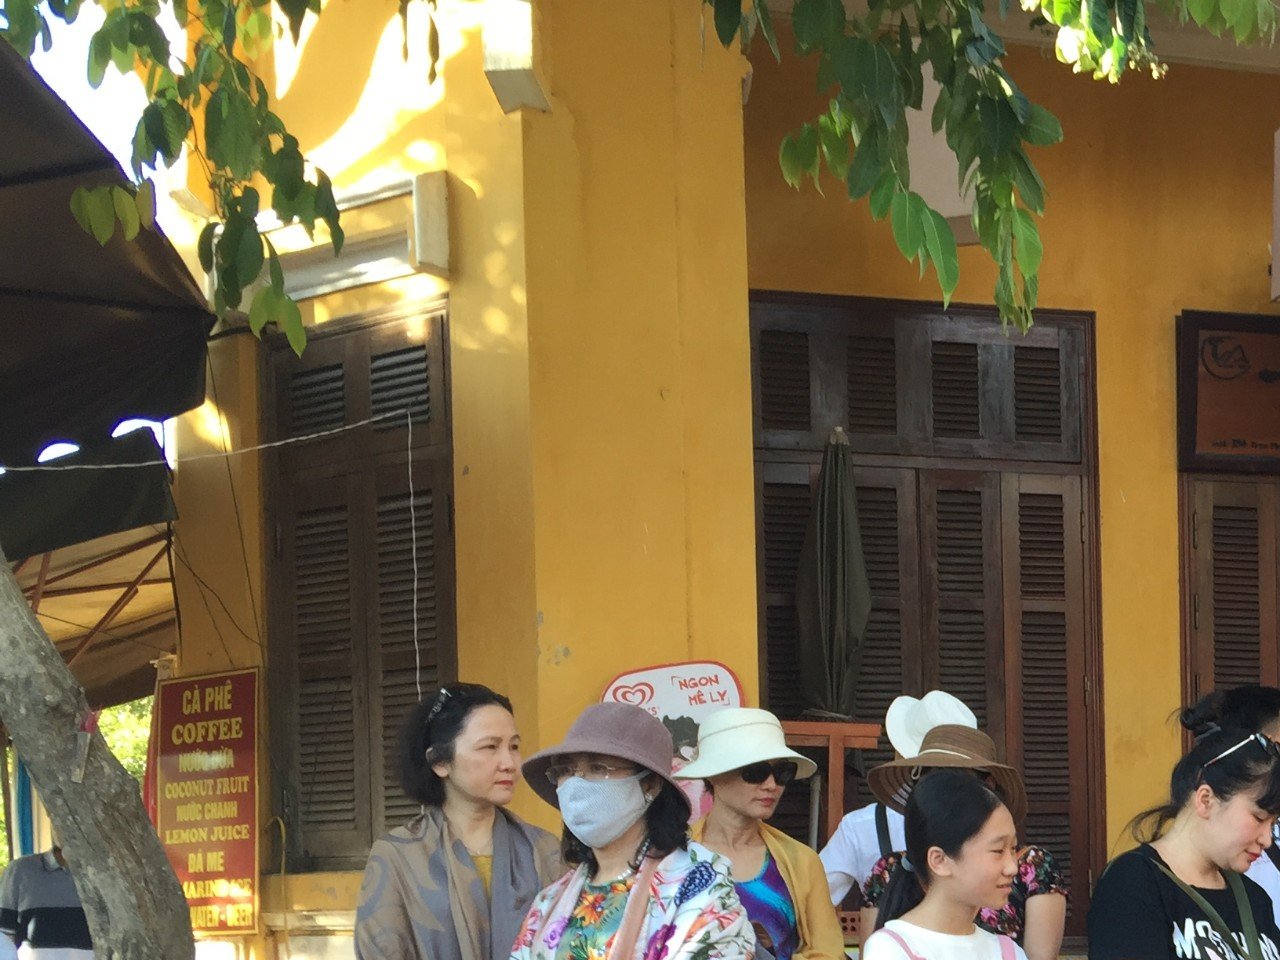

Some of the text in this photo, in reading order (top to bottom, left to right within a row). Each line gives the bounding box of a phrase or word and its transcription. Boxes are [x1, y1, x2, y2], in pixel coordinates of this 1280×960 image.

[679, 674, 720, 690] NGON
[182, 680, 232, 716] CÀ PHÊ
[710, 690, 728, 702] LY
[171, 717, 243, 745] COFFEE
[165, 775, 250, 799] COCONUT FRUIT
[204, 800, 238, 820] CHANH
[165, 824, 250, 845] LEMON JUICE
[207, 851, 224, 872] ME
